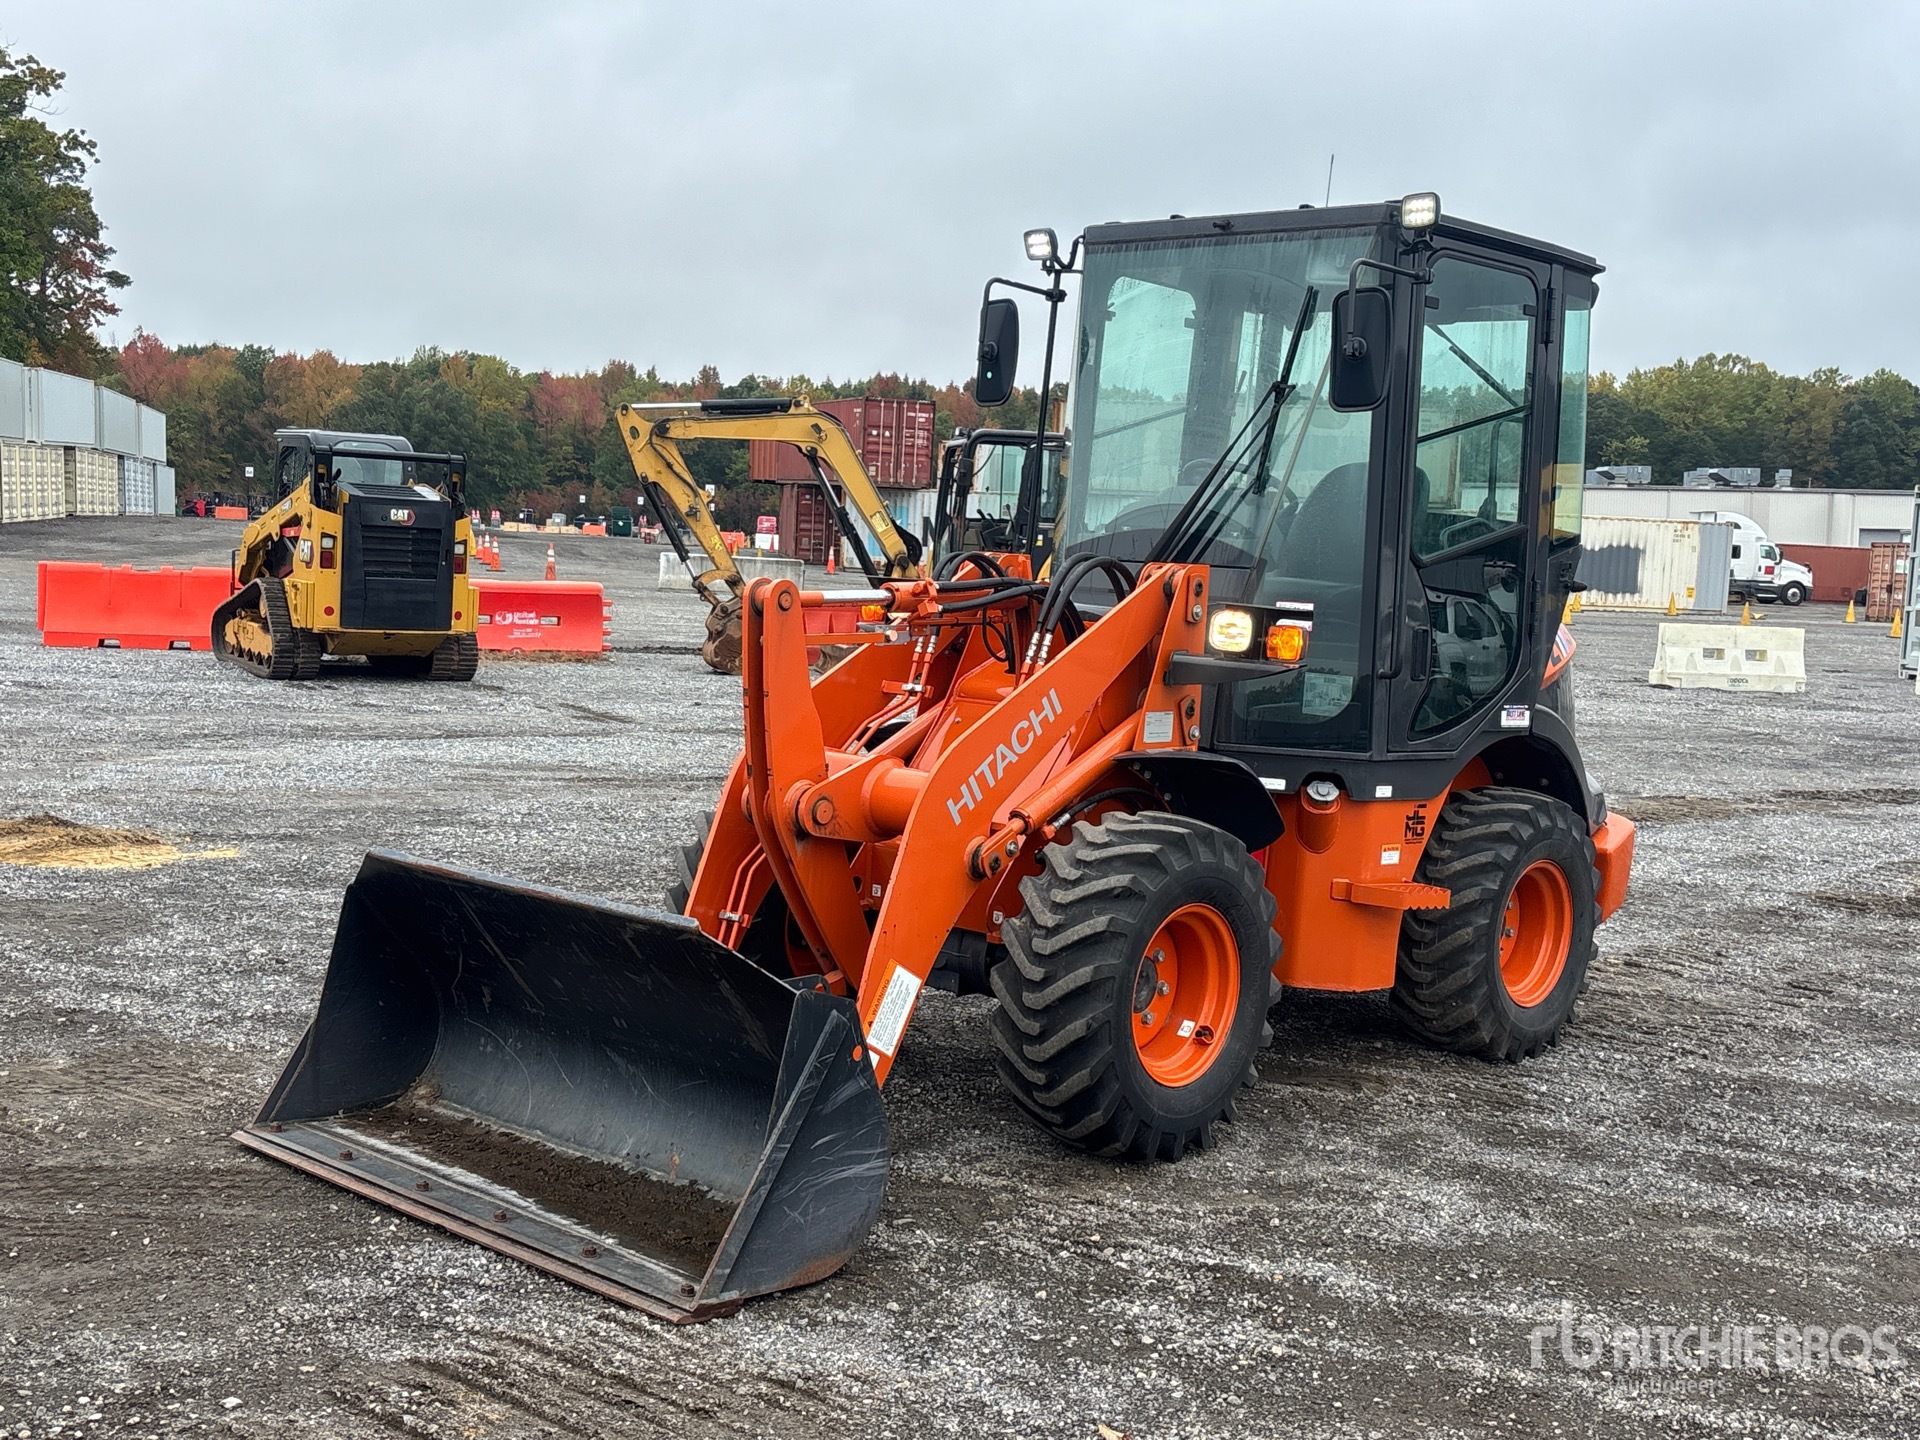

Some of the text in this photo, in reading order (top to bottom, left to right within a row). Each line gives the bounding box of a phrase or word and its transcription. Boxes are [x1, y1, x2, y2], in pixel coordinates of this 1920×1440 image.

[390, 509, 409, 521] CAT
[946, 687, 1063, 826] HITACHI
[872, 978, 890, 1017] WARNING
